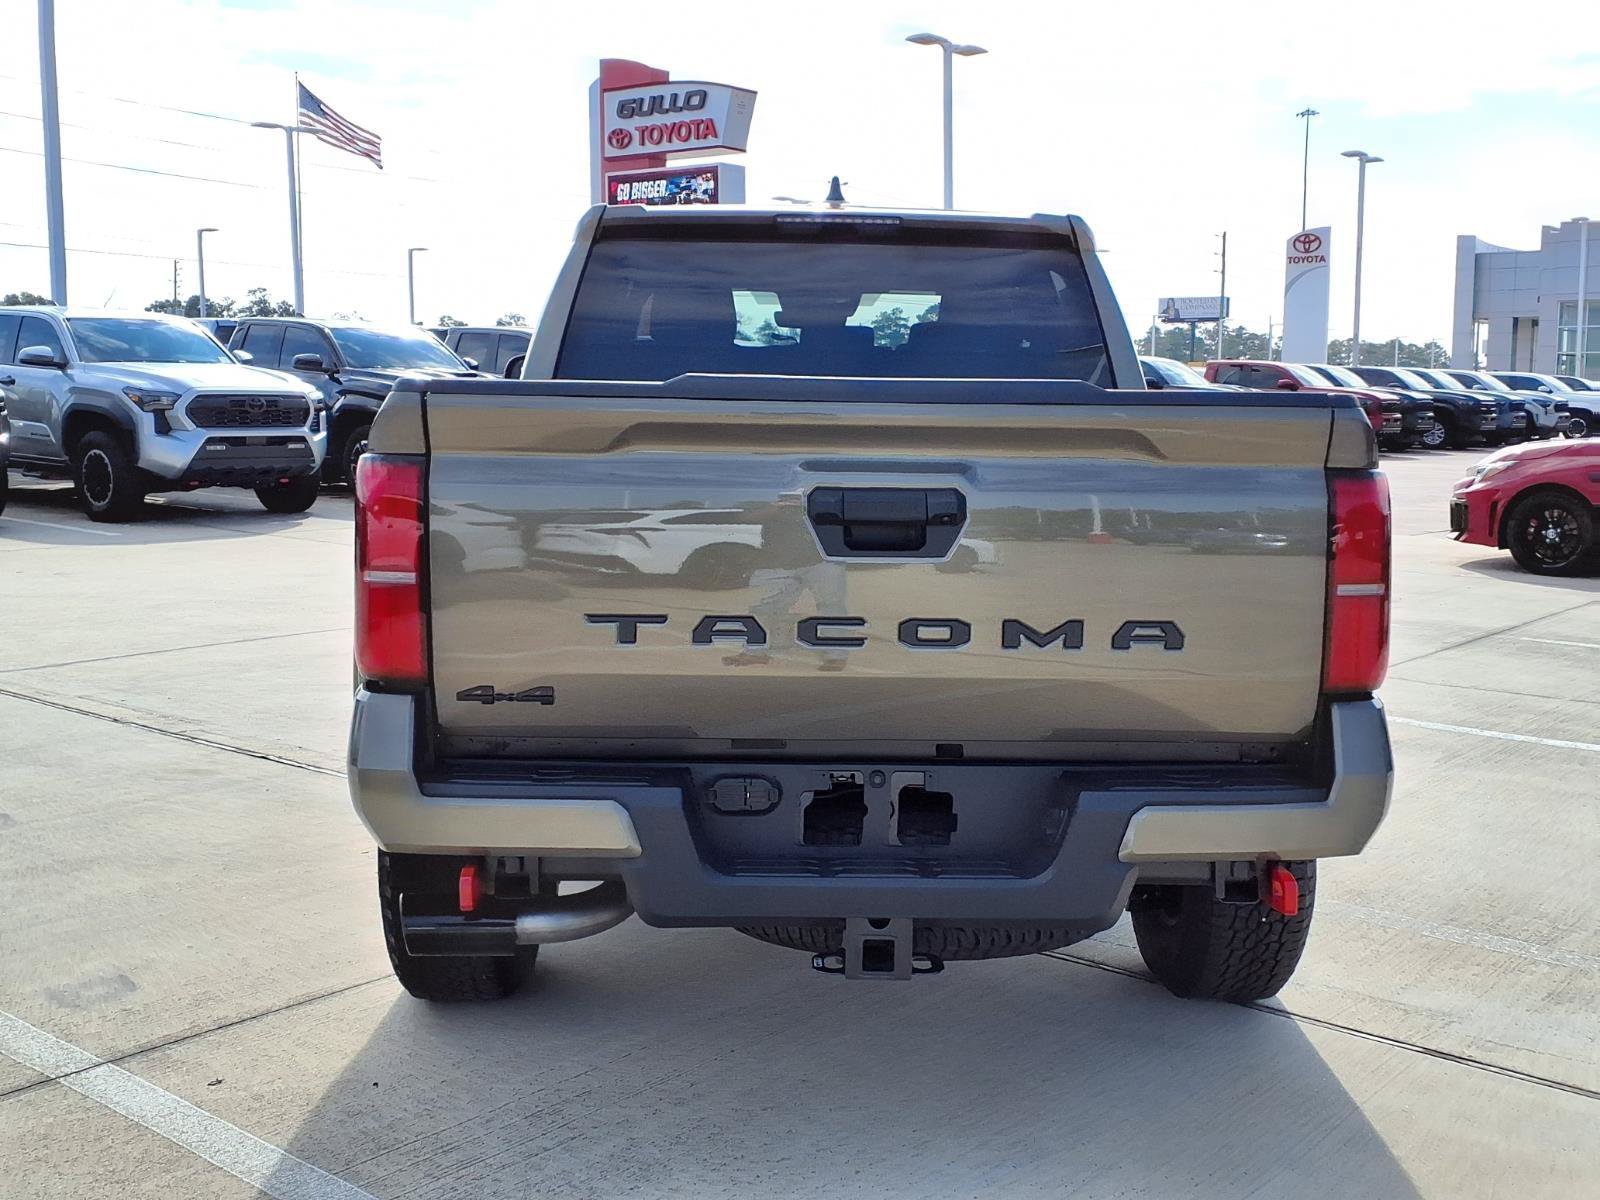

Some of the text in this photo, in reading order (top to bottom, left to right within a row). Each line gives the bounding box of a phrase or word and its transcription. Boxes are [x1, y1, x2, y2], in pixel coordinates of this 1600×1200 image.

[616, 89, 707, 119] GULLO
[635, 118, 718, 146] TOYOTA
[617, 182, 631, 201] GO
[1287, 255, 1327, 264] TOYOTA
[584, 613, 1185, 650] TACOMA
